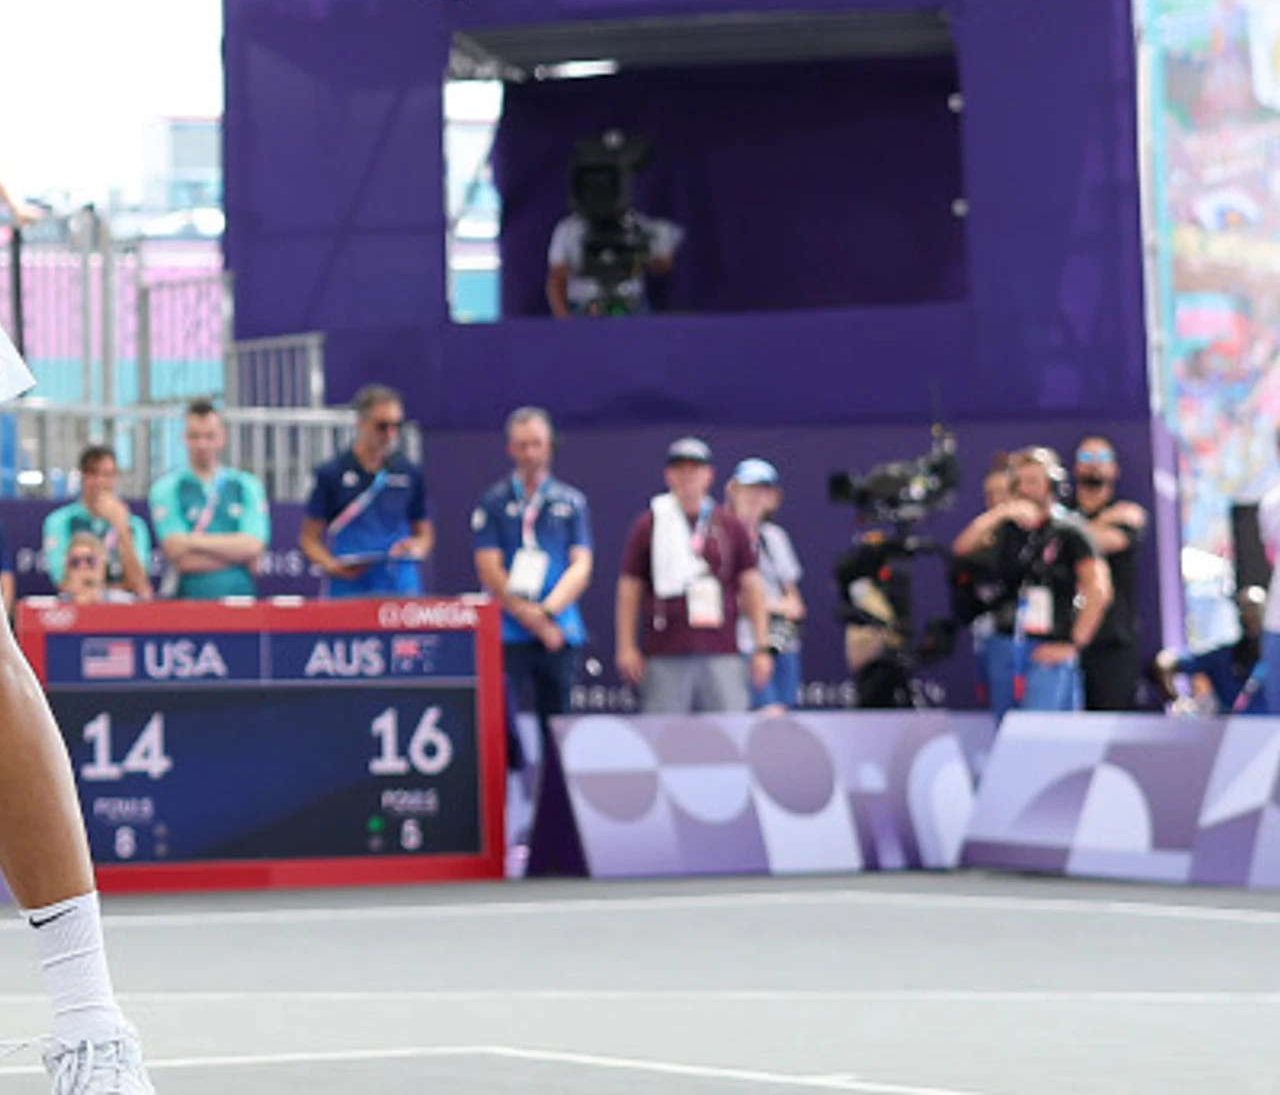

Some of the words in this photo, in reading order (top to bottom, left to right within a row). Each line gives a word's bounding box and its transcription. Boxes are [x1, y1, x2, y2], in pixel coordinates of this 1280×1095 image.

[144, 643, 227, 679] USA
[305, 639, 384, 676] AUS
[81, 713, 173, 781] 14
[368, 707, 452, 775] 16
